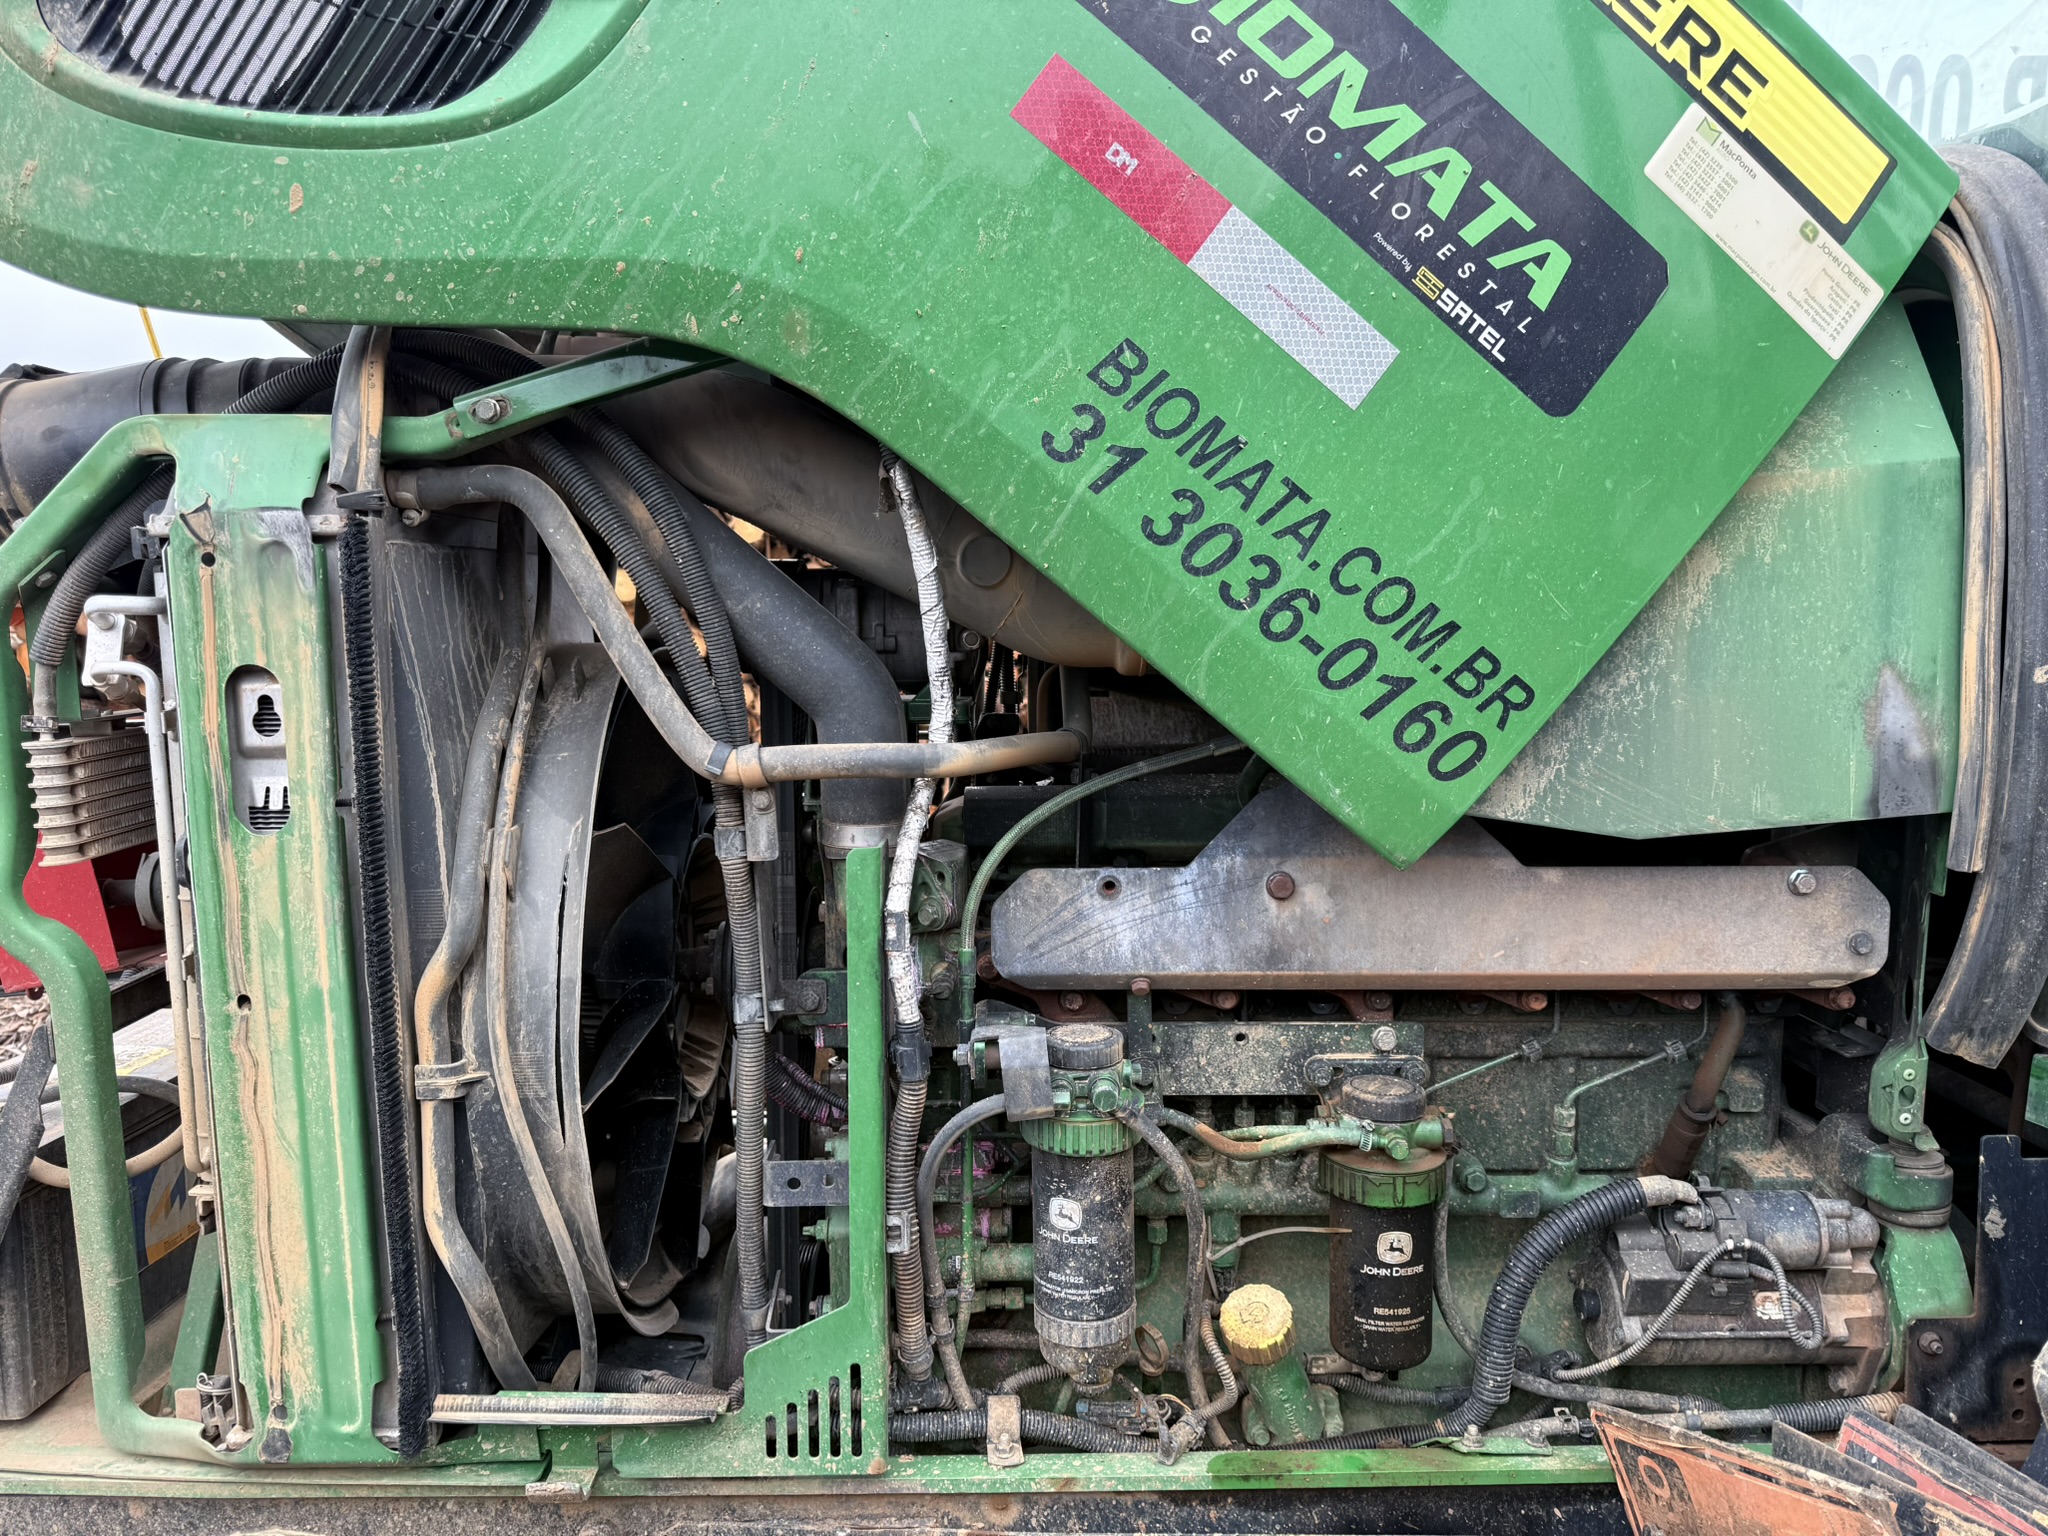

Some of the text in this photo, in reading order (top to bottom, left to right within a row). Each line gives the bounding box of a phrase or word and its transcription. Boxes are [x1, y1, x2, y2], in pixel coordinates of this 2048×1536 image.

[1191, 25, 1533, 334] GESTÃO FLORESTAL
[1719, 140, 1758, 178] MacPonta
[1373, 231, 1413, 273] Powered by
[1816, 240, 1872, 295] JOHN DEERE
[1436, 288, 1507, 362] SATEL
[1086, 337, 1535, 731] BIOMATA.COM.BR
[1041, 403, 1148, 495] 31
[1141, 488, 1487, 782] 3036-0160
[1039, 1226, 1098, 1244] JOHN DEERE
[1360, 1264, 1424, 1276] JOHN DEERE
[1373, 1307, 1411, 1316] RE541925
